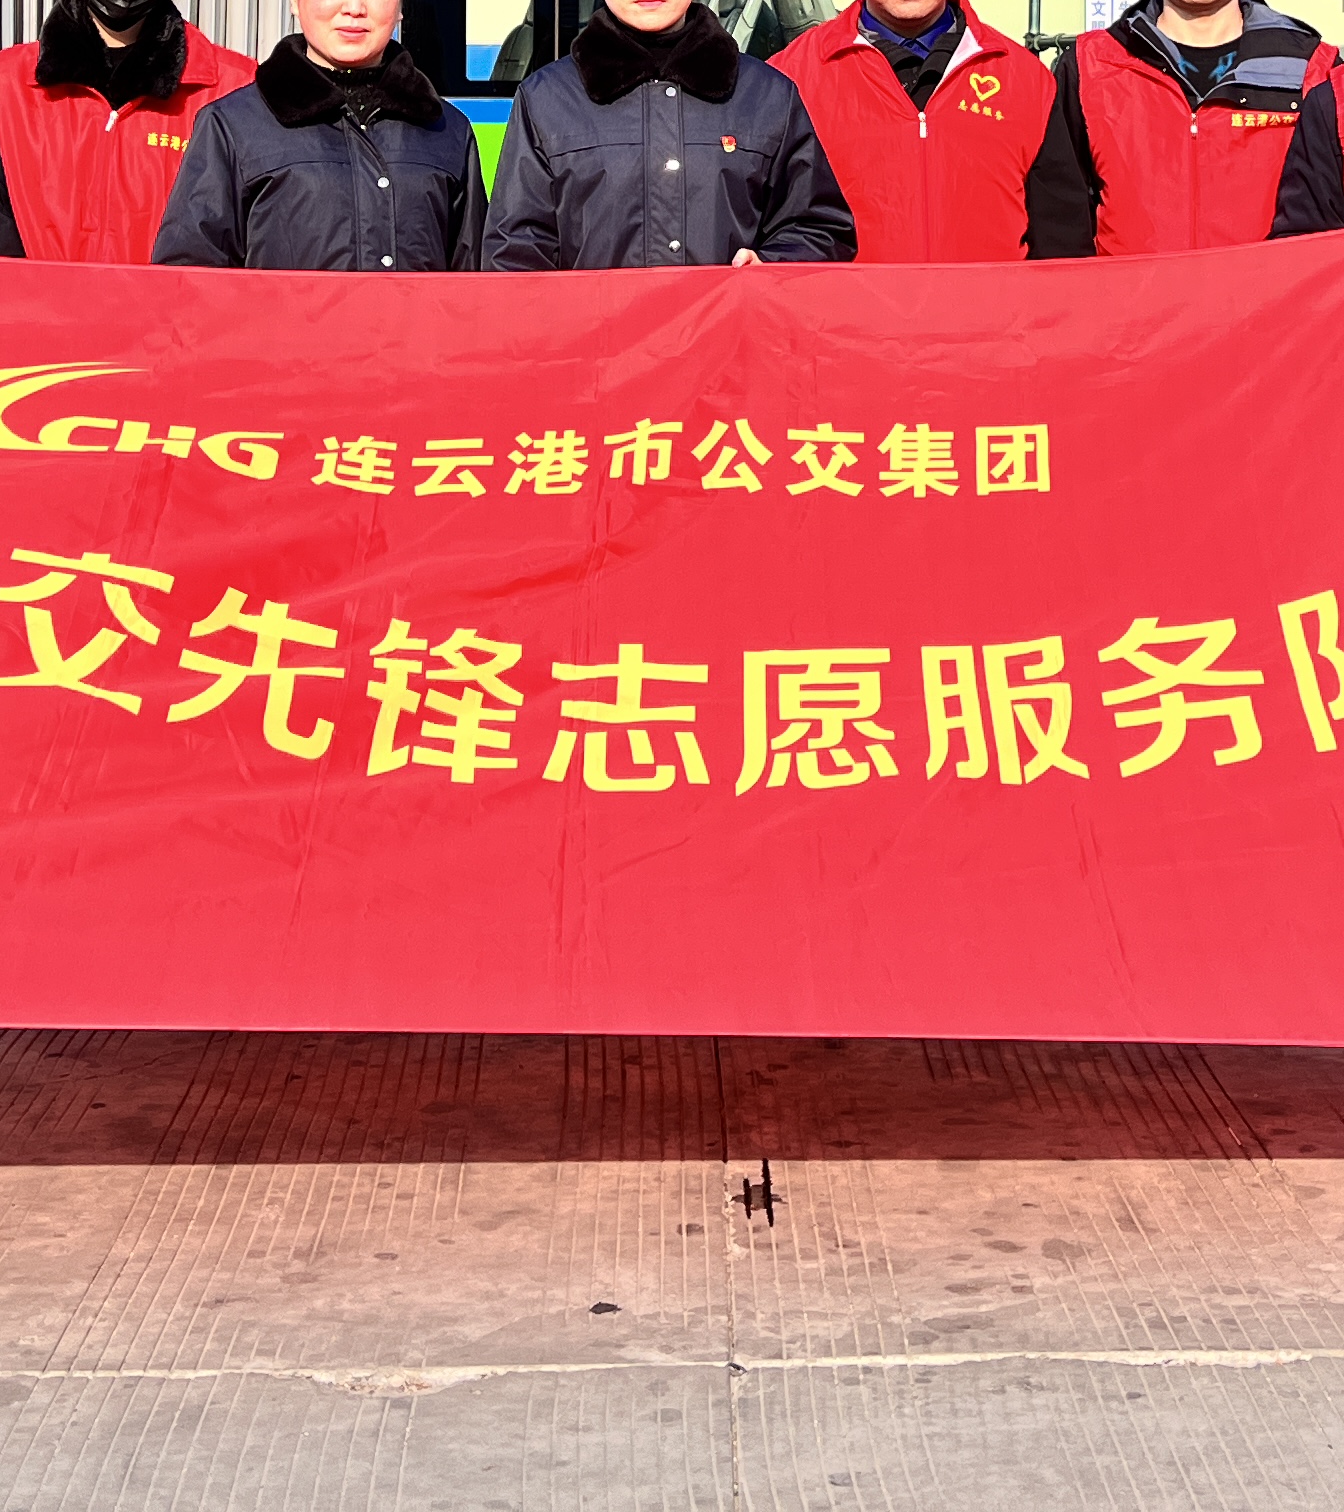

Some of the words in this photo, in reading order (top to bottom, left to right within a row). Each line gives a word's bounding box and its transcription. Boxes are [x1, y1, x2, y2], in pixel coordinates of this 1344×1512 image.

[310, 417, 1052, 498] 连云港市公交集团
